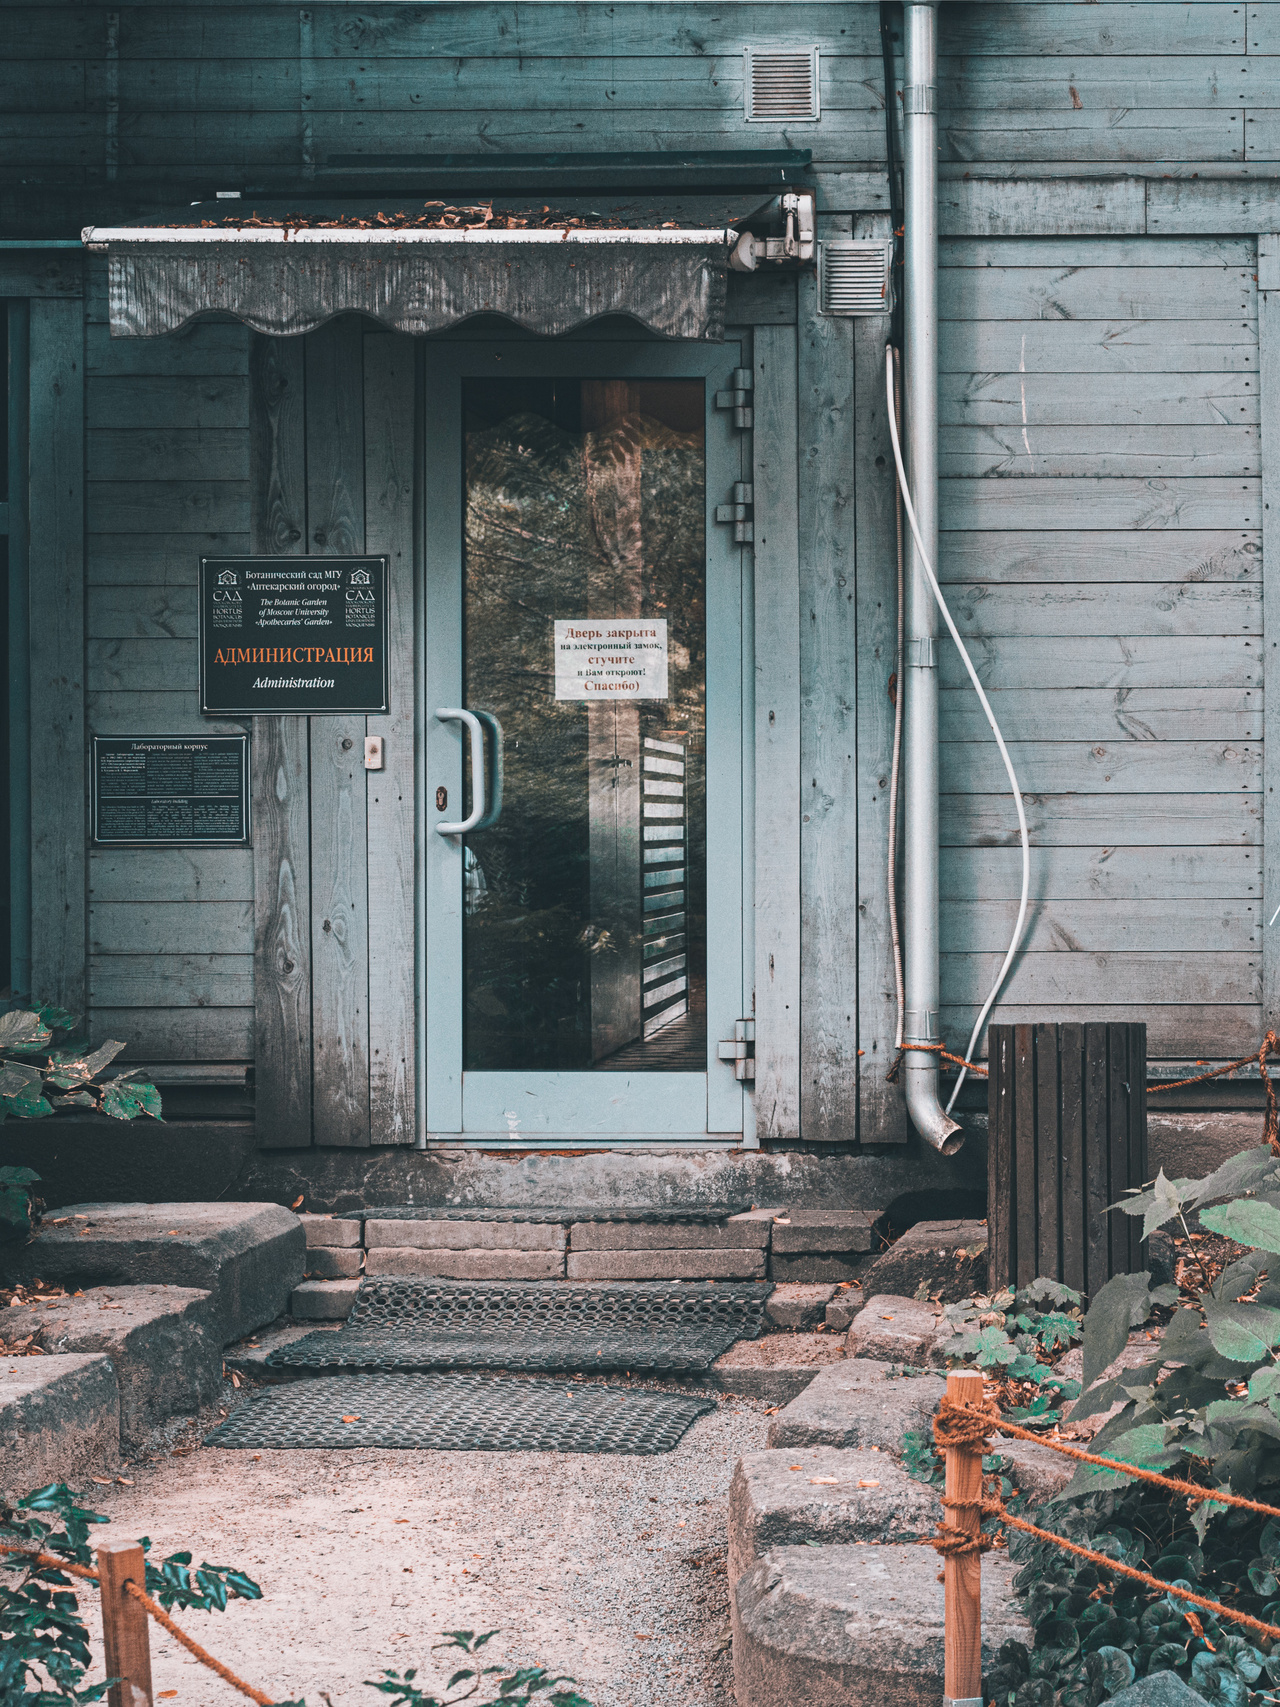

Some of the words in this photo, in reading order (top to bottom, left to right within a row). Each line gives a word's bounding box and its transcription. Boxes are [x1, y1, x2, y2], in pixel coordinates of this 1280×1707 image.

[245, 570, 306, 580] Ботанический
[308, 572, 322, 580] сад
[324, 571, 342, 579] МГУ
[246, 582, 305, 592] «Аптекарский
[306, 583, 340, 592] огород»
[213, 590, 242, 601] САД
[345, 590, 375, 601] САД
[274, 598, 300, 606] Botanic
[259, 608, 266, 617] of
[294, 608, 329, 618] University
[303, 618, 332, 626] Garden»
[565, 628, 602, 640] Дверь
[606, 629, 656, 640] закрыта
[573, 642, 631, 651] электронный
[214, 647, 374, 666] АДМИНИСТРАЦИЯ
[588, 656, 635, 666] стучите
[605, 668, 646, 677] откроют!
[252, 677, 335, 689] Administration
[584, 681, 640, 692] Спасибо)
[131, 743, 182, 751] Лабораторный
